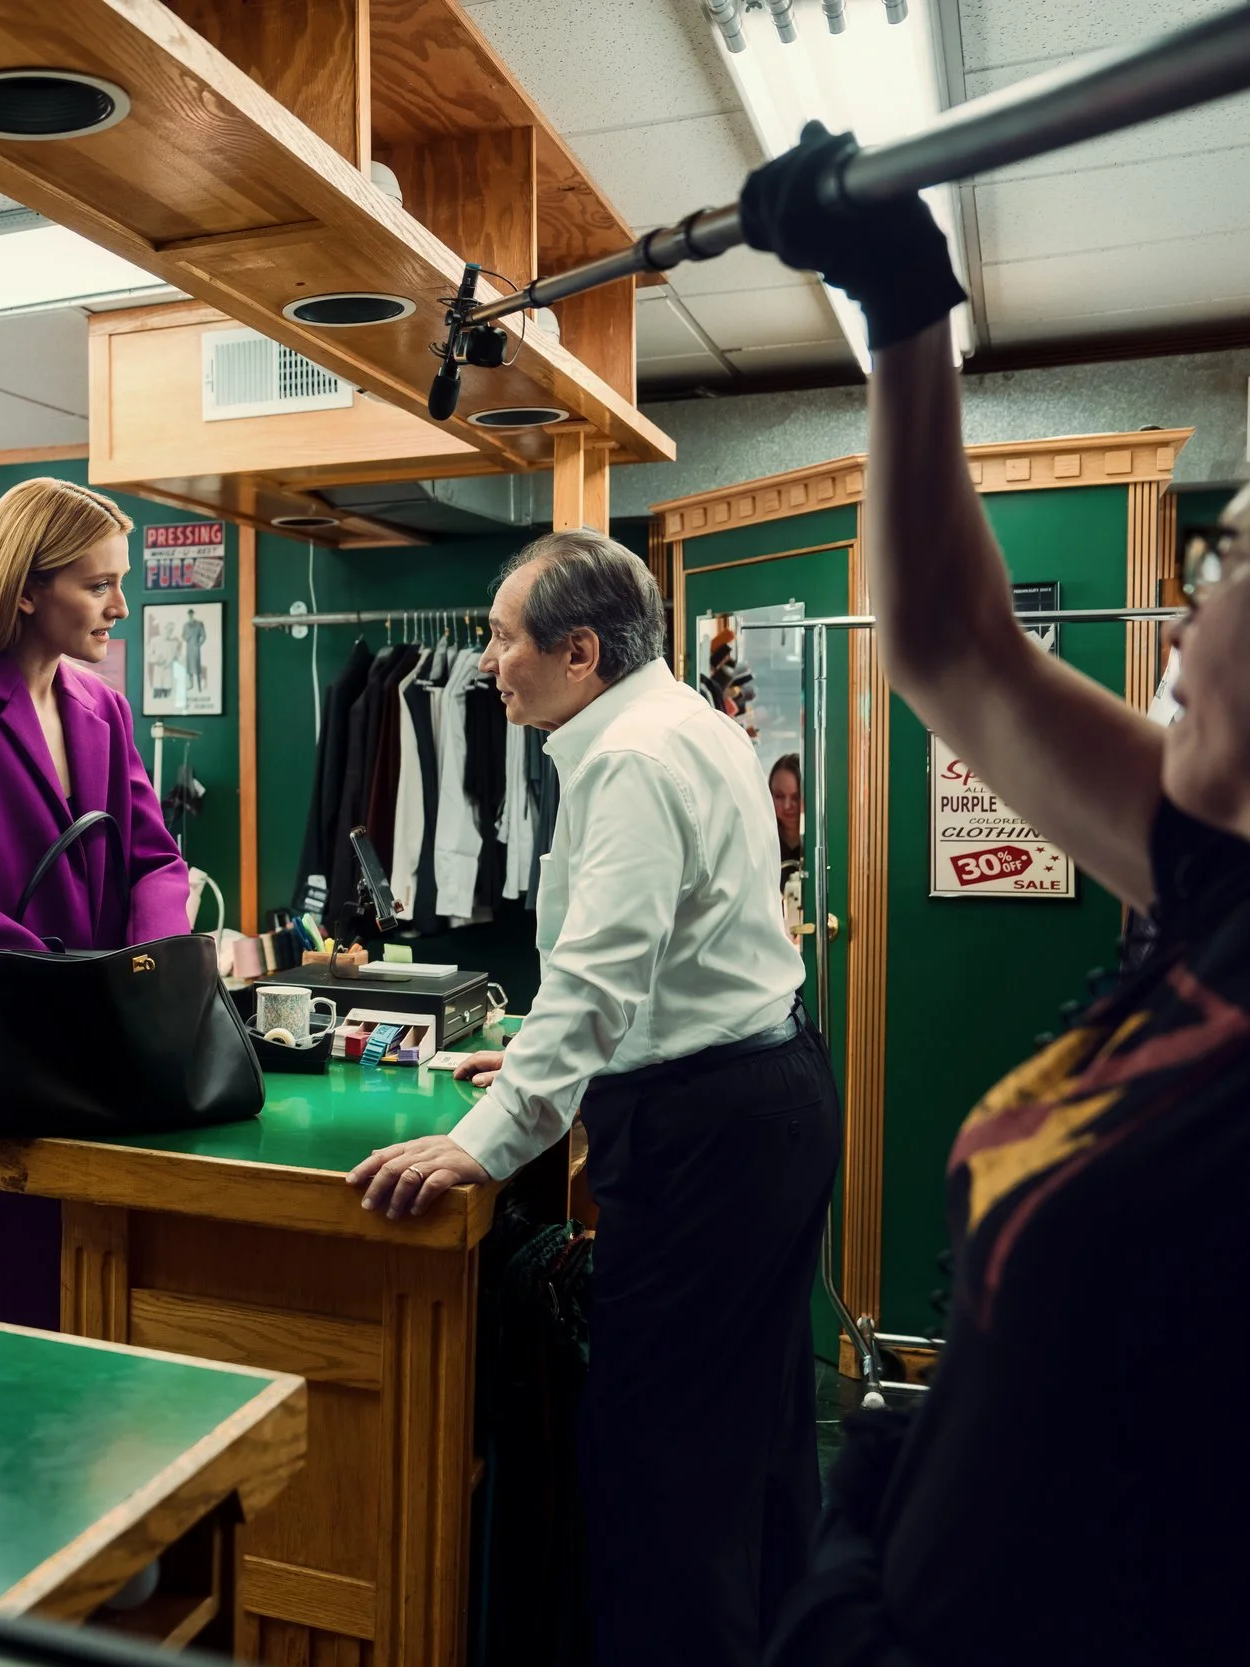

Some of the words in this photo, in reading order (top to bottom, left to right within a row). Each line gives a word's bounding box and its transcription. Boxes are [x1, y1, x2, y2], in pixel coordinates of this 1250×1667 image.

[147, 524, 222, 547] PRESSING
[941, 796, 997, 813] PURPLE
[941, 827, 1042, 838] CLOTHIN
[1003, 861, 1023, 873] OFF
[1013, 880, 1061, 890] SALE
